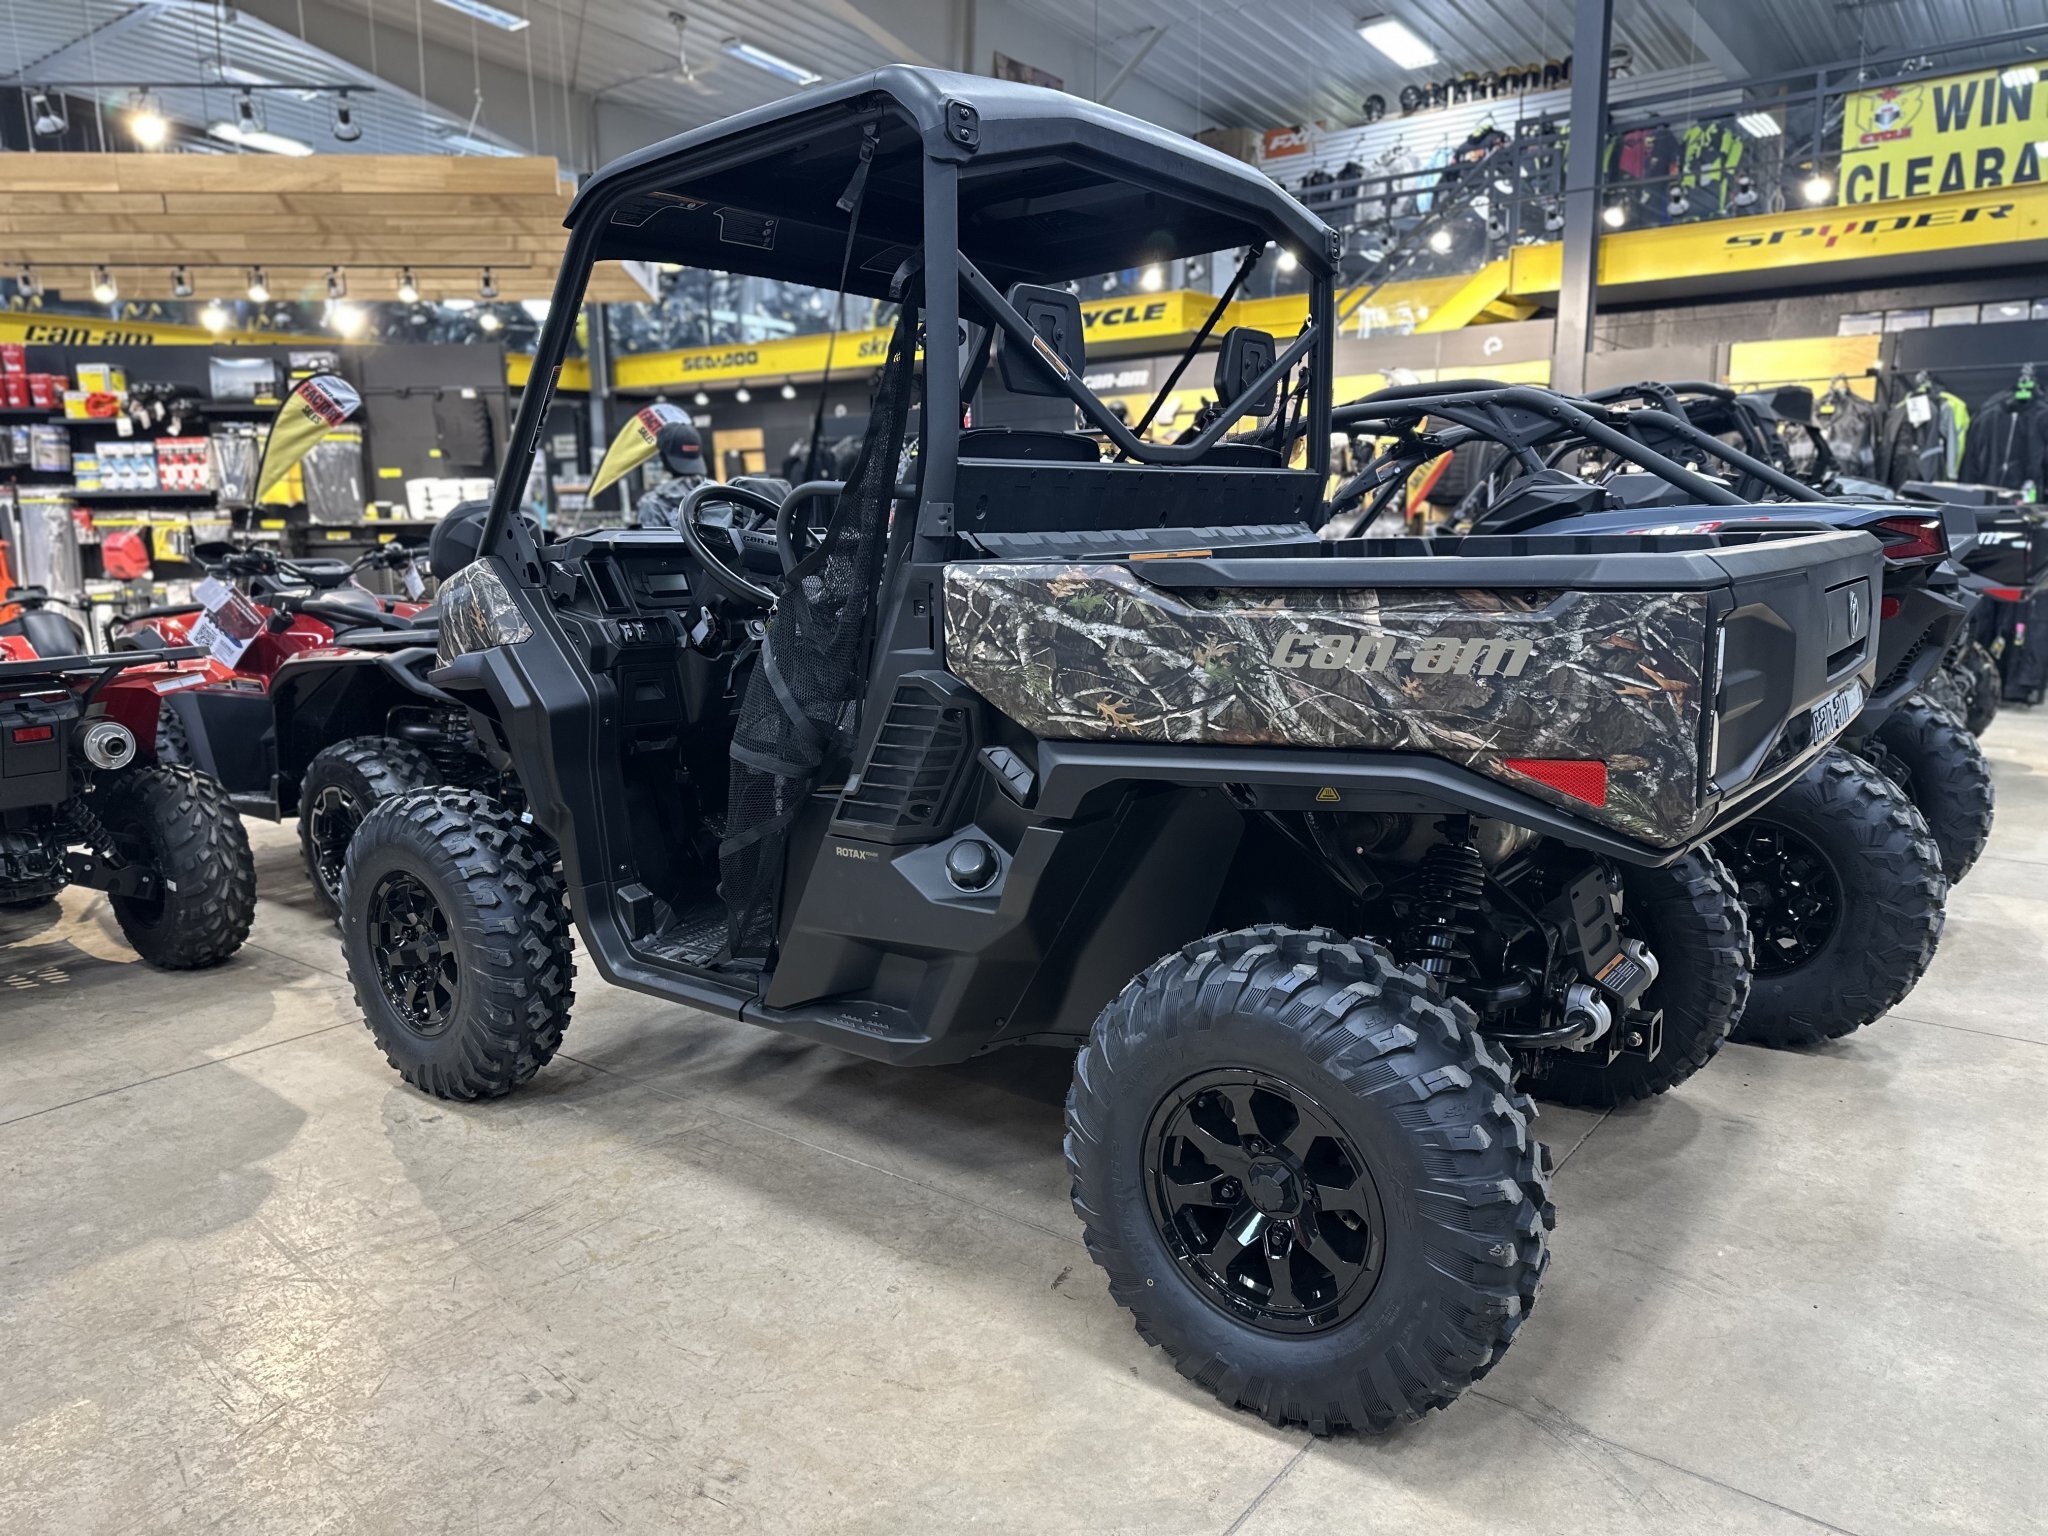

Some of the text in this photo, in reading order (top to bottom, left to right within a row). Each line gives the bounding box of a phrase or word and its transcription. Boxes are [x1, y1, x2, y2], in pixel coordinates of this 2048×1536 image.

[1846, 141, 2040, 205] CLEARA
[1724, 204, 2015, 248] SPYDER
[1082, 303, 1167, 328] YCLE
[25, 325, 154, 345] can-am
[858, 336, 887, 358] ski
[1083, 370, 1149, 390] can-am
[302, 405, 322, 424] SALES
[638, 427, 654, 444] SALES
[1270, 634, 1534, 677] can-am
[836, 846, 866, 860] ROTAX
